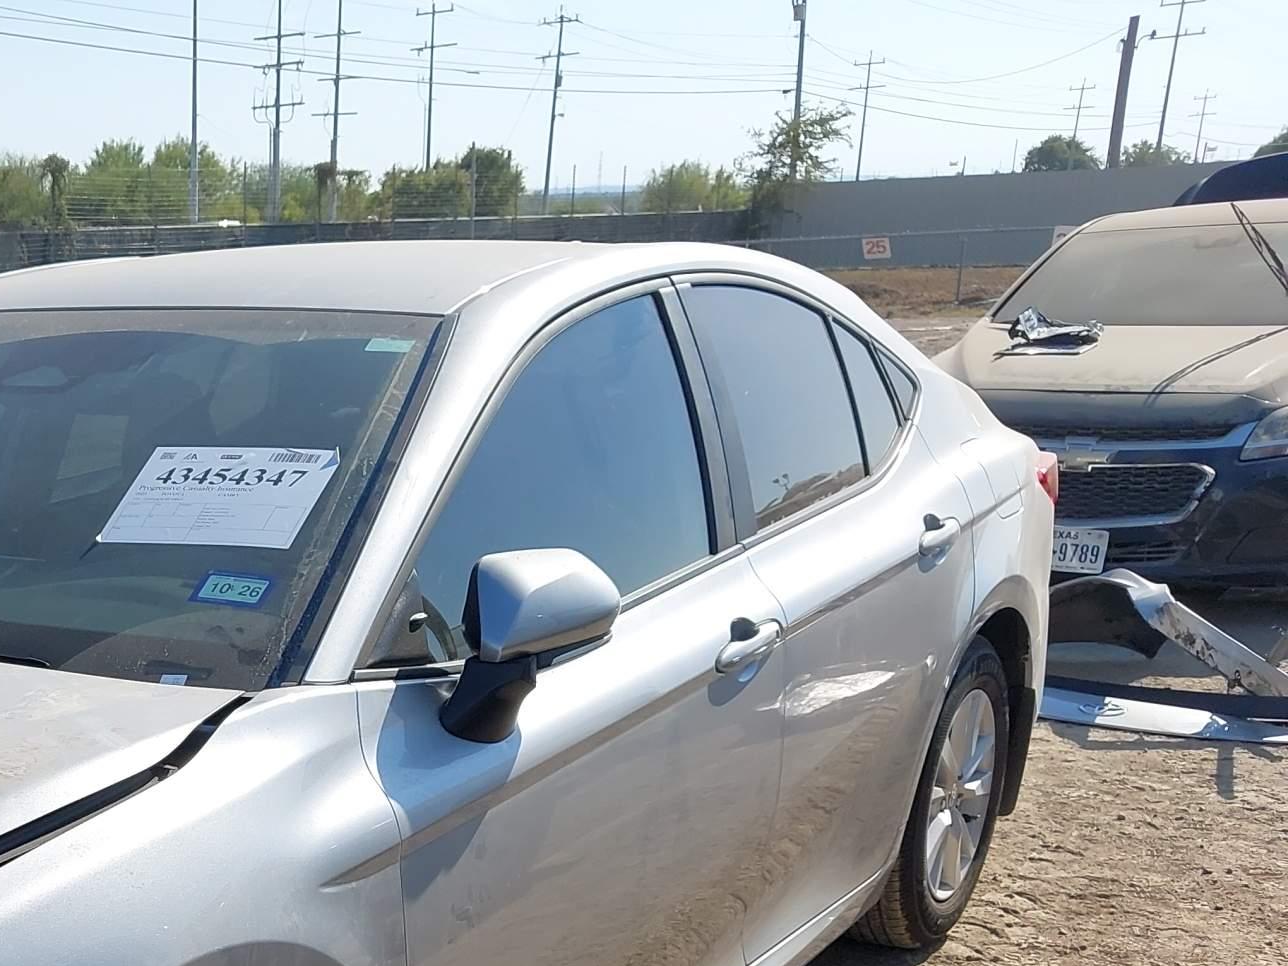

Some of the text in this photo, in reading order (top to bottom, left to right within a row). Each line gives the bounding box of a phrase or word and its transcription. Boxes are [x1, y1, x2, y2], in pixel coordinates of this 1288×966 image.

[865, 240, 887, 255] 25
[156, 467, 309, 488] 43454347
[1058, 542, 1100, 564] 9789
[238, 585, 262, 597] 26
